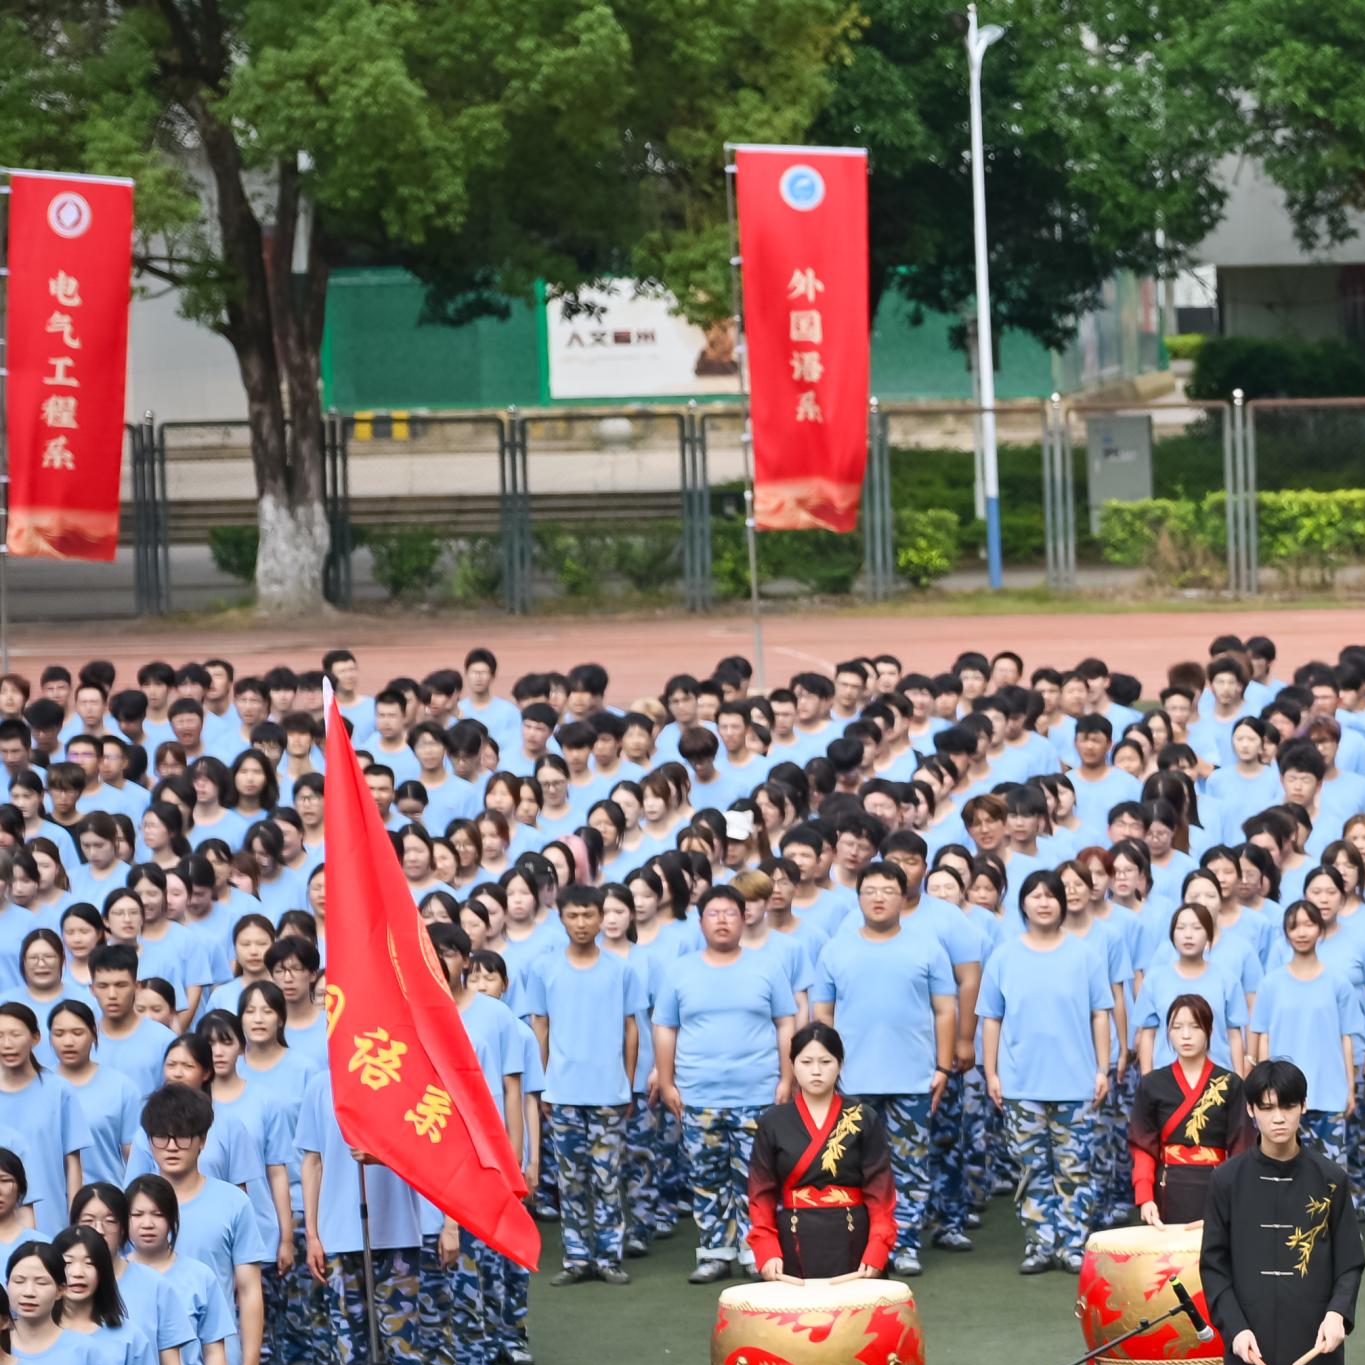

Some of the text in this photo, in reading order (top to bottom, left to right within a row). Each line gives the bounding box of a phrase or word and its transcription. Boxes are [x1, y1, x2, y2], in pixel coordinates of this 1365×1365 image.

[41, 269, 82, 471] 电气工程系
[787, 267, 825, 424] 外国语系
